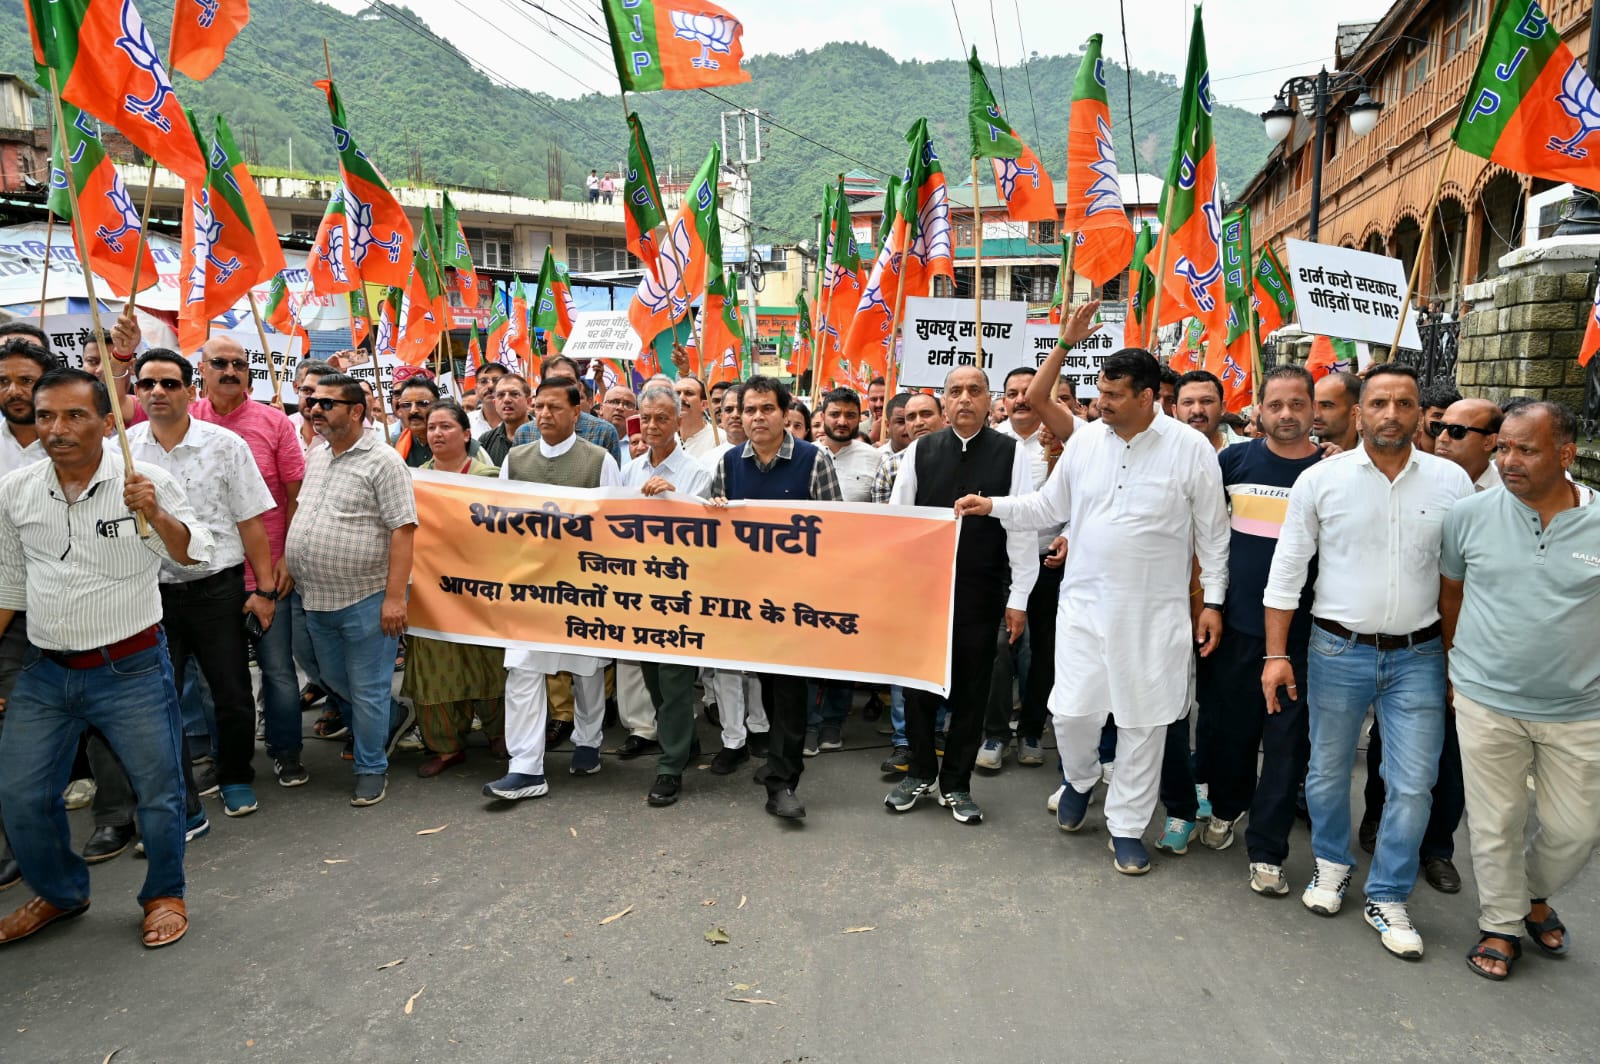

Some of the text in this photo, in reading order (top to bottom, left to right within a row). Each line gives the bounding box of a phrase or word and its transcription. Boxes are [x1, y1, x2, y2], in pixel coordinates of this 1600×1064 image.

[1299, 266, 1402, 301] शर्म करो सरकार,
[1308, 288, 1400, 320] पीड़ितों पर FIR?
[50, 332, 76, 350] बाढ़
[915, 319, 958, 341] सुक्खू
[1101, 334, 1113, 349] के
[572, 341, 588, 350] FIR
[928, 346, 956, 366] शर्म
[350, 367, 383, 380] सहाया
[469, 501, 823, 557] भारतीय जनता पार्टी
[577, 551, 689, 580] जिला मंडी
[439, 575, 859, 635] आपदा प्रभावितों पर दर्ज FIR के विरुद्ध
[565, 615, 705, 650] विरोध प्रदर्शन
